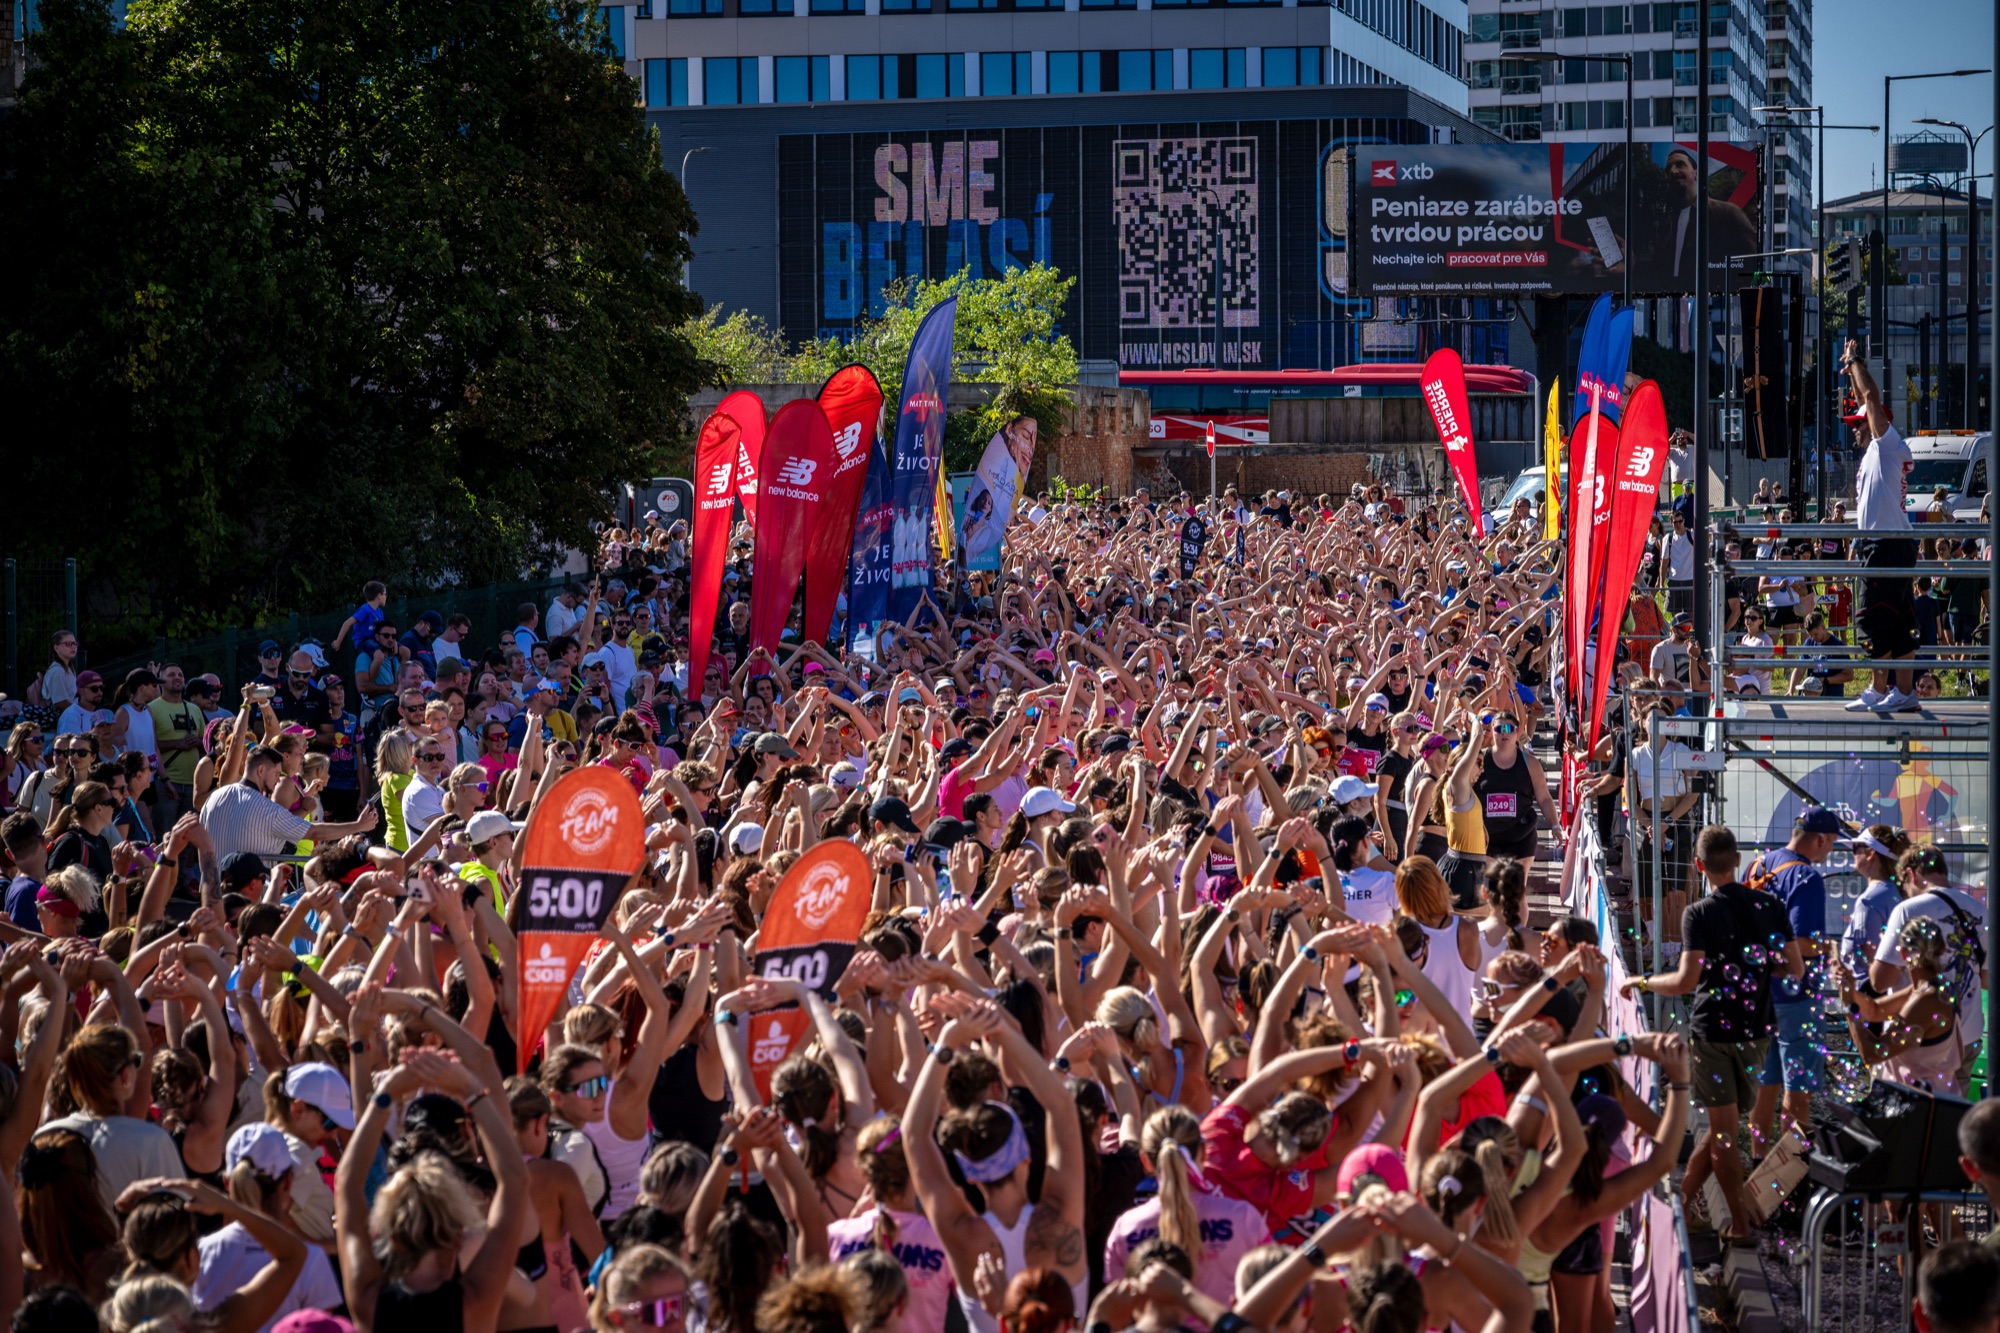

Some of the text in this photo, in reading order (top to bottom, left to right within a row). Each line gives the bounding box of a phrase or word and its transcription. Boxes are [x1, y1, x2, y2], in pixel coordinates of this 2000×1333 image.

[1401, 162, 1434, 180] xtb
[874, 140, 999, 226] SME
[1371, 194, 1583, 217] Peniaze zarábate
[1371, 219, 1544, 246] tvrdou prácou
[1372, 251, 1546, 266] Nechajte ich pracovať pre Vás
[1420, 282, 1435, 290] ktoré
[1119, 341, 1262, 365] WWW.HCSLOVN.SK
[1150, 424, 1162, 433] GO
[914, 433, 924, 450] JE
[838, 452, 867, 475] alance
[897, 452, 940, 470] ŽIVOT
[768, 485, 819, 502] new balance
[1619, 479, 1655, 494] new balance
[701, 497, 714, 510] new
[873, 544, 890, 563] JE
[854, 567, 891, 586] ŽIVO
[1488, 801, 1509, 810] 8249
[559, 805, 620, 842] TEAM
[528, 877, 604, 919] 5:00
[793, 874, 850, 919] TEAM
